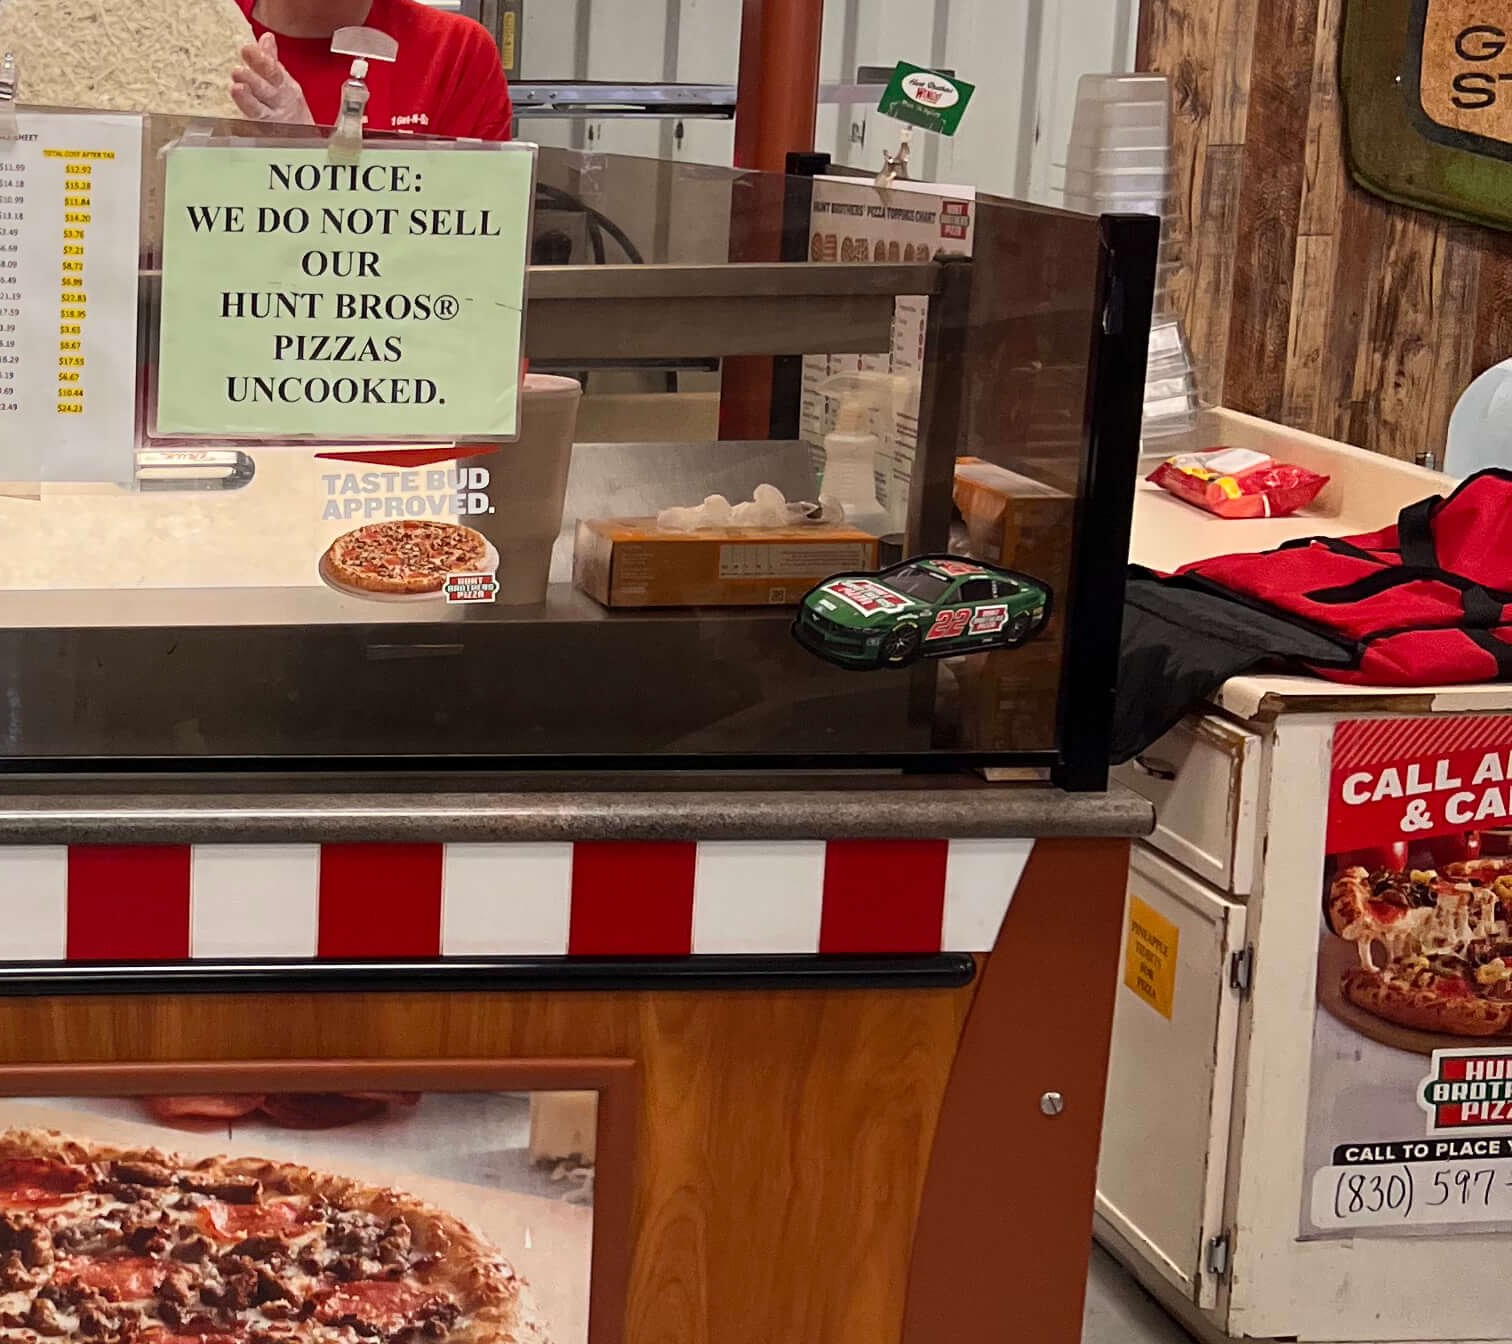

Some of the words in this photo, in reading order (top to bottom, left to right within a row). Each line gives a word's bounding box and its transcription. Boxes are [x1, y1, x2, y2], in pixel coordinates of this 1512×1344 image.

[269, 164, 423, 192] NOTICE:
[186, 207, 244, 233] WE
[258, 207, 309, 234] DO
[321, 208, 399, 235] NOT
[409, 210, 501, 237] SELL
[301, 251, 381, 277] OUR
[220, 292, 323, 318] HUNT
[336, 294, 460, 320] BROS®
[273, 335, 403, 362] PIZZAS
[227, 377, 446, 405] UNCOOKED.
[322, 471, 419, 495] TASTE
[426, 468, 489, 491] BUD
[321, 492, 495, 520] APPROVED.
[925, 608, 972, 640] 22
[1342, 763, 1462, 806] CALL
[1400, 803, 1434, 832] &
[1345, 1147, 1395, 1161] CALL
[1403, 1145, 1428, 1158] TO
[1436, 1141, 1500, 1156] PLACE
[1335, 1165, 1413, 1218] (830)
[1425, 1169, 1495, 1205] 597
